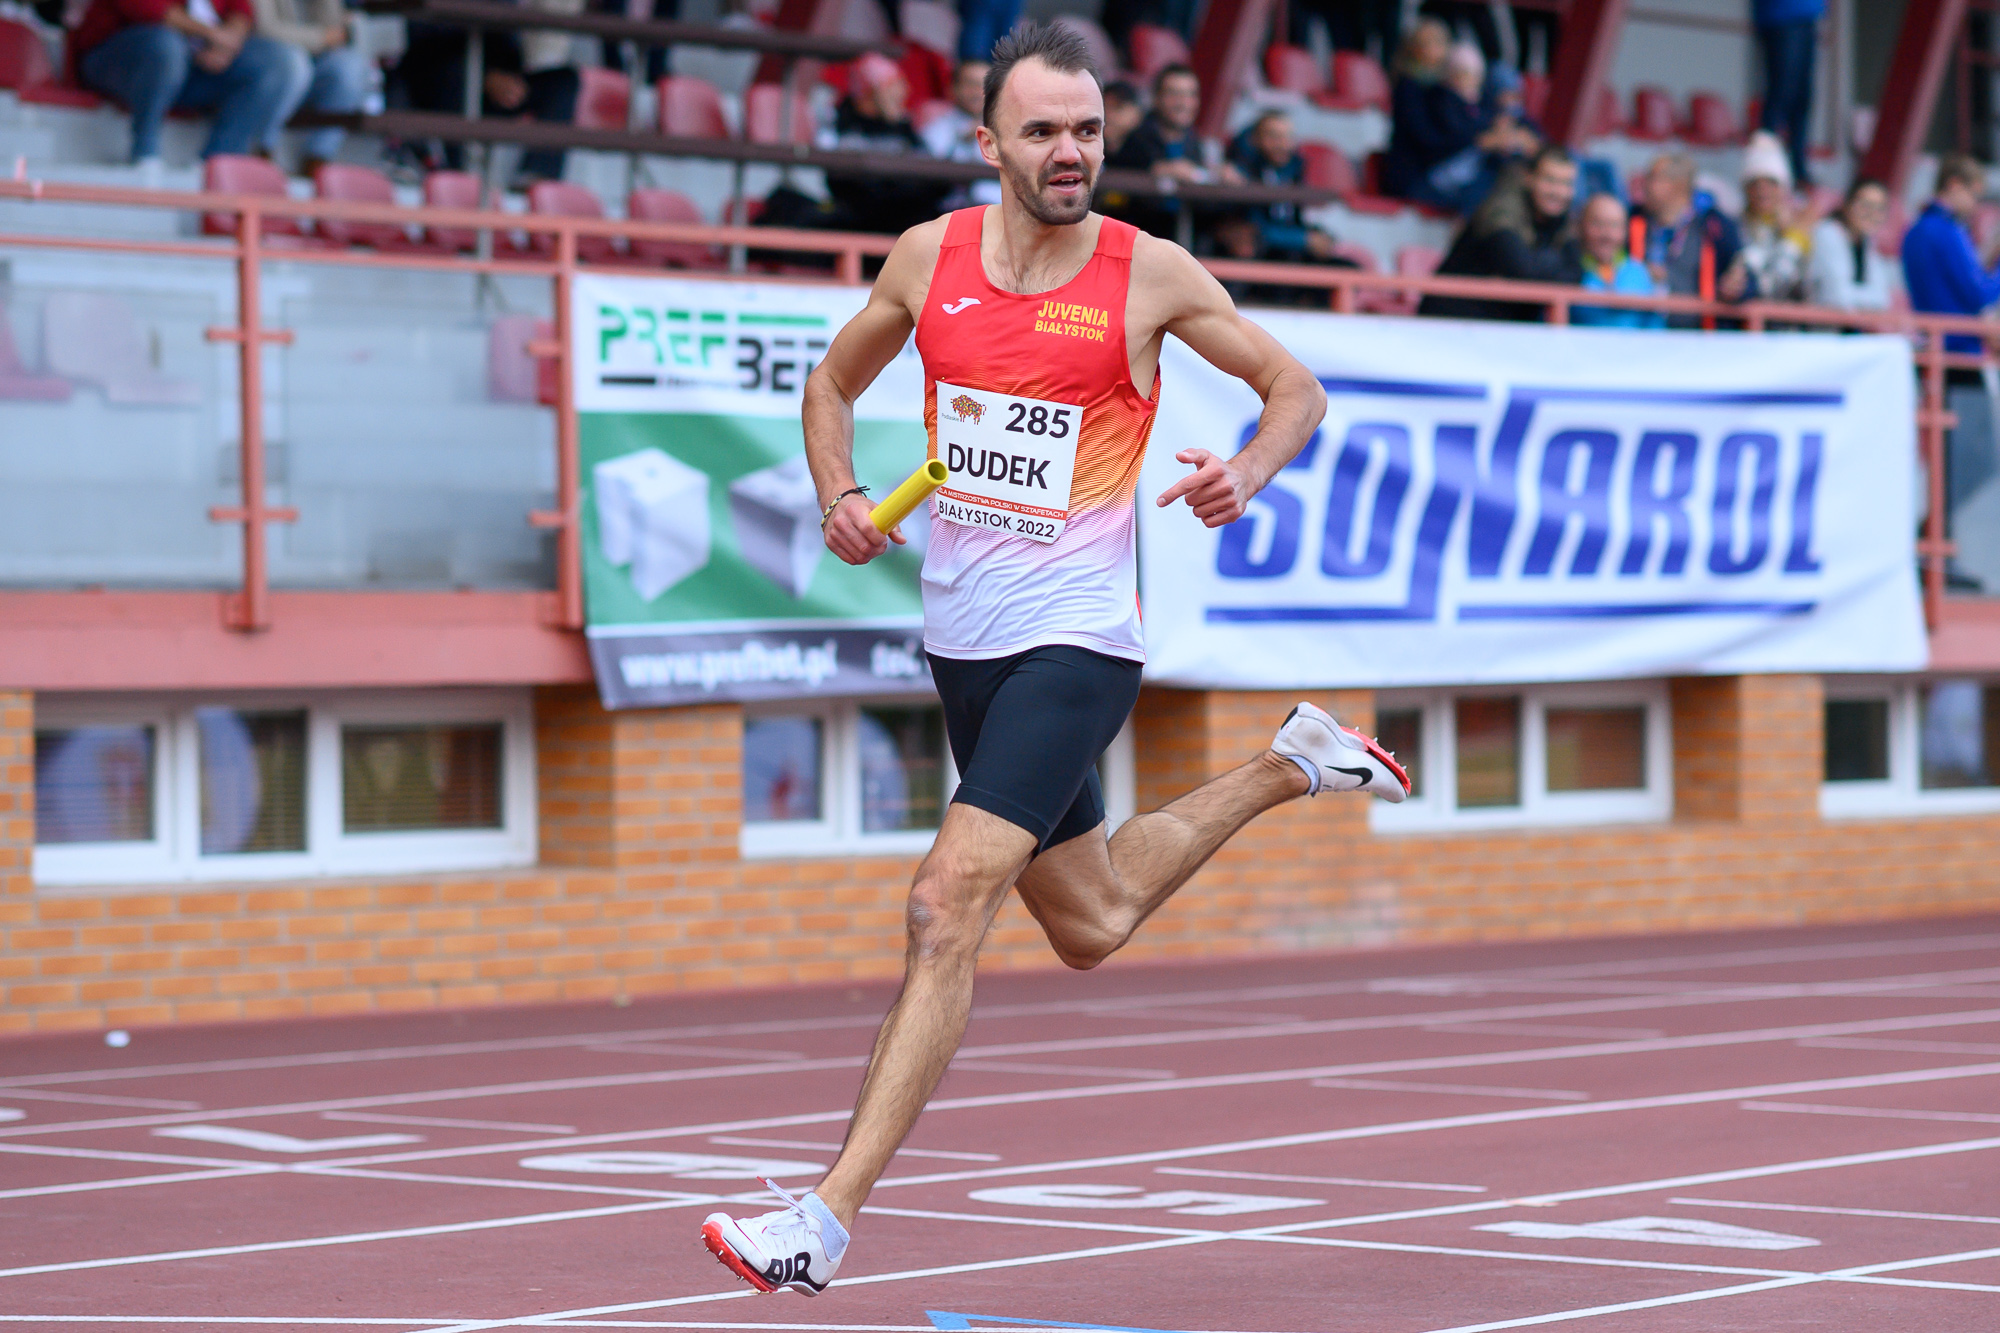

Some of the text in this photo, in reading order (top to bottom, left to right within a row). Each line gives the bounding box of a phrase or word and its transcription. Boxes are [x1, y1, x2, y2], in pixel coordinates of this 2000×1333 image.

[1034, 319, 1106, 343] BIAŁYSTOK
[1037, 300, 1108, 328] JUVENIA
[599, 305, 727, 366] PREF
[1004, 402, 1071, 439] 285
[947, 442, 1052, 490] DUDEK
[938, 500, 1056, 539] BIAŁYSTOK 2022
[948, 488, 990, 505] MISTRZOSTWA
[990, 499, 1013, 510] POLSKI
[1020, 505, 1064, 518] SZTAFETACH
[1214, 398, 1828, 620] SONAROL
[763, 1251, 822, 1287] AIR
